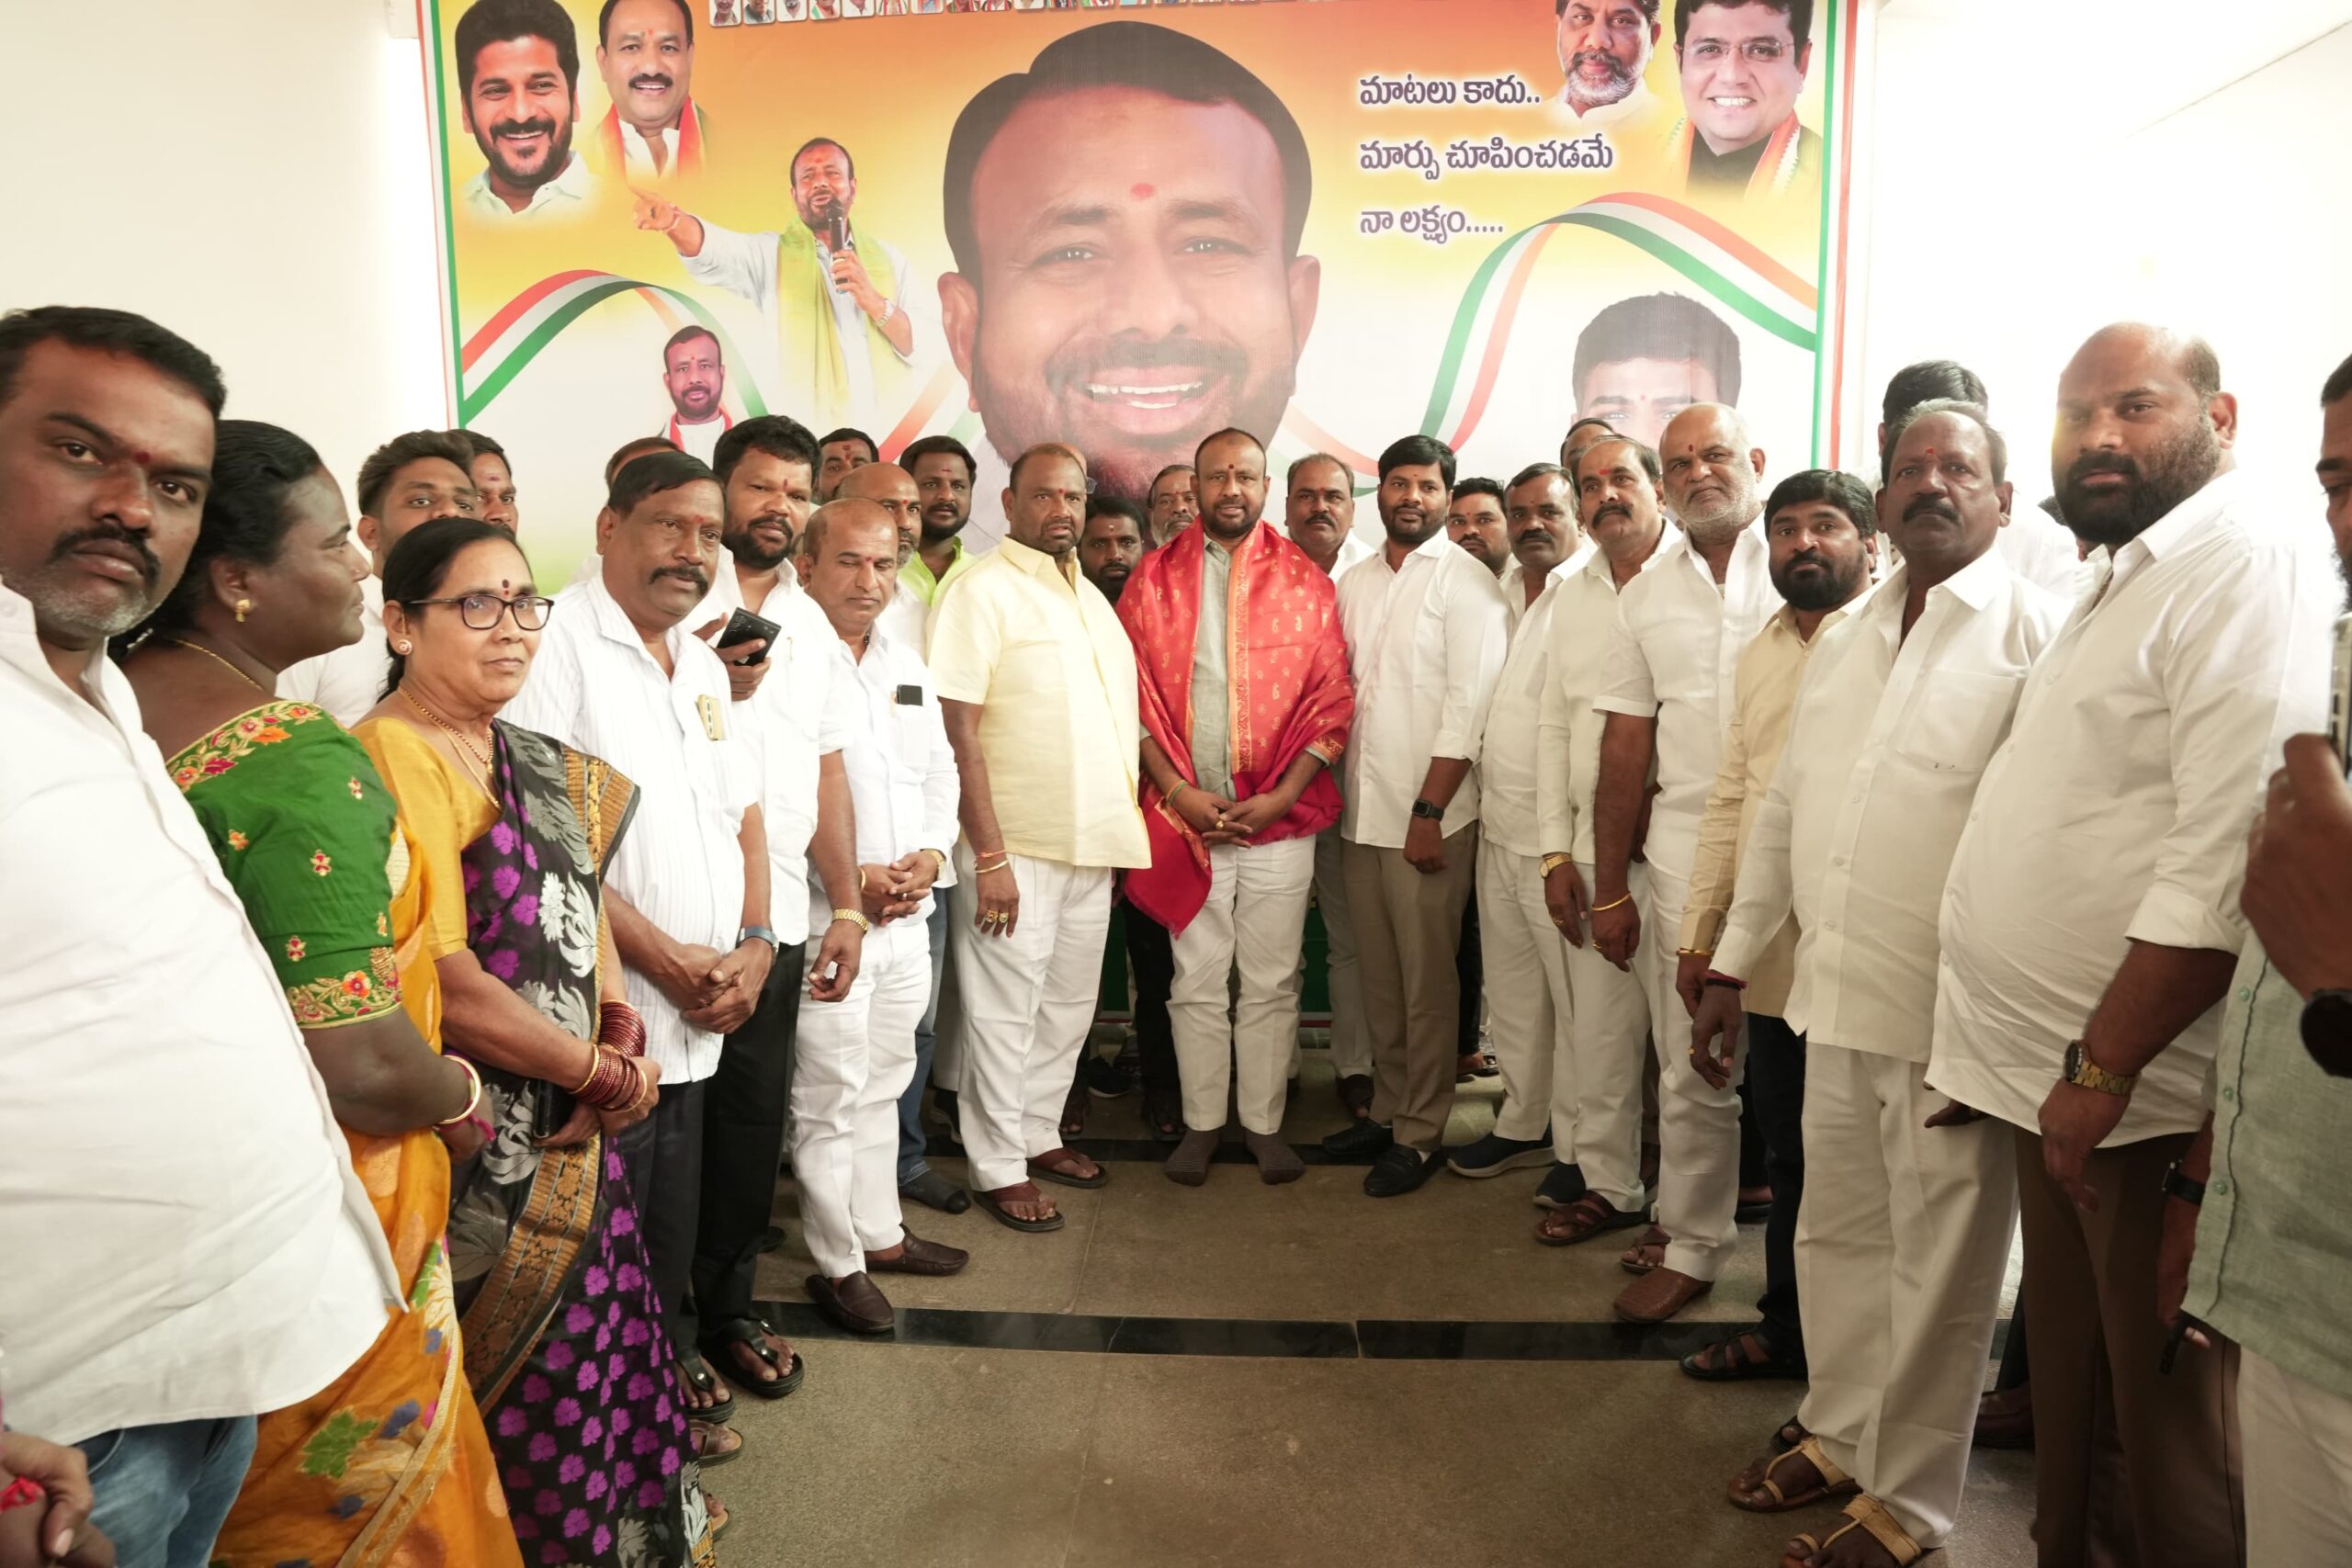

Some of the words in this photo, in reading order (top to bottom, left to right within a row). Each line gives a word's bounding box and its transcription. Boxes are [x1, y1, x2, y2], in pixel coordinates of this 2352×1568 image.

[1360, 73, 1456, 104] మాటలు
[1464, 74, 1540, 104] కాదు..
[1360, 140, 1441, 180] మార్పు
[1445, 133, 1613, 169] చూపించడమే
[1360, 209, 1394, 233] నా
